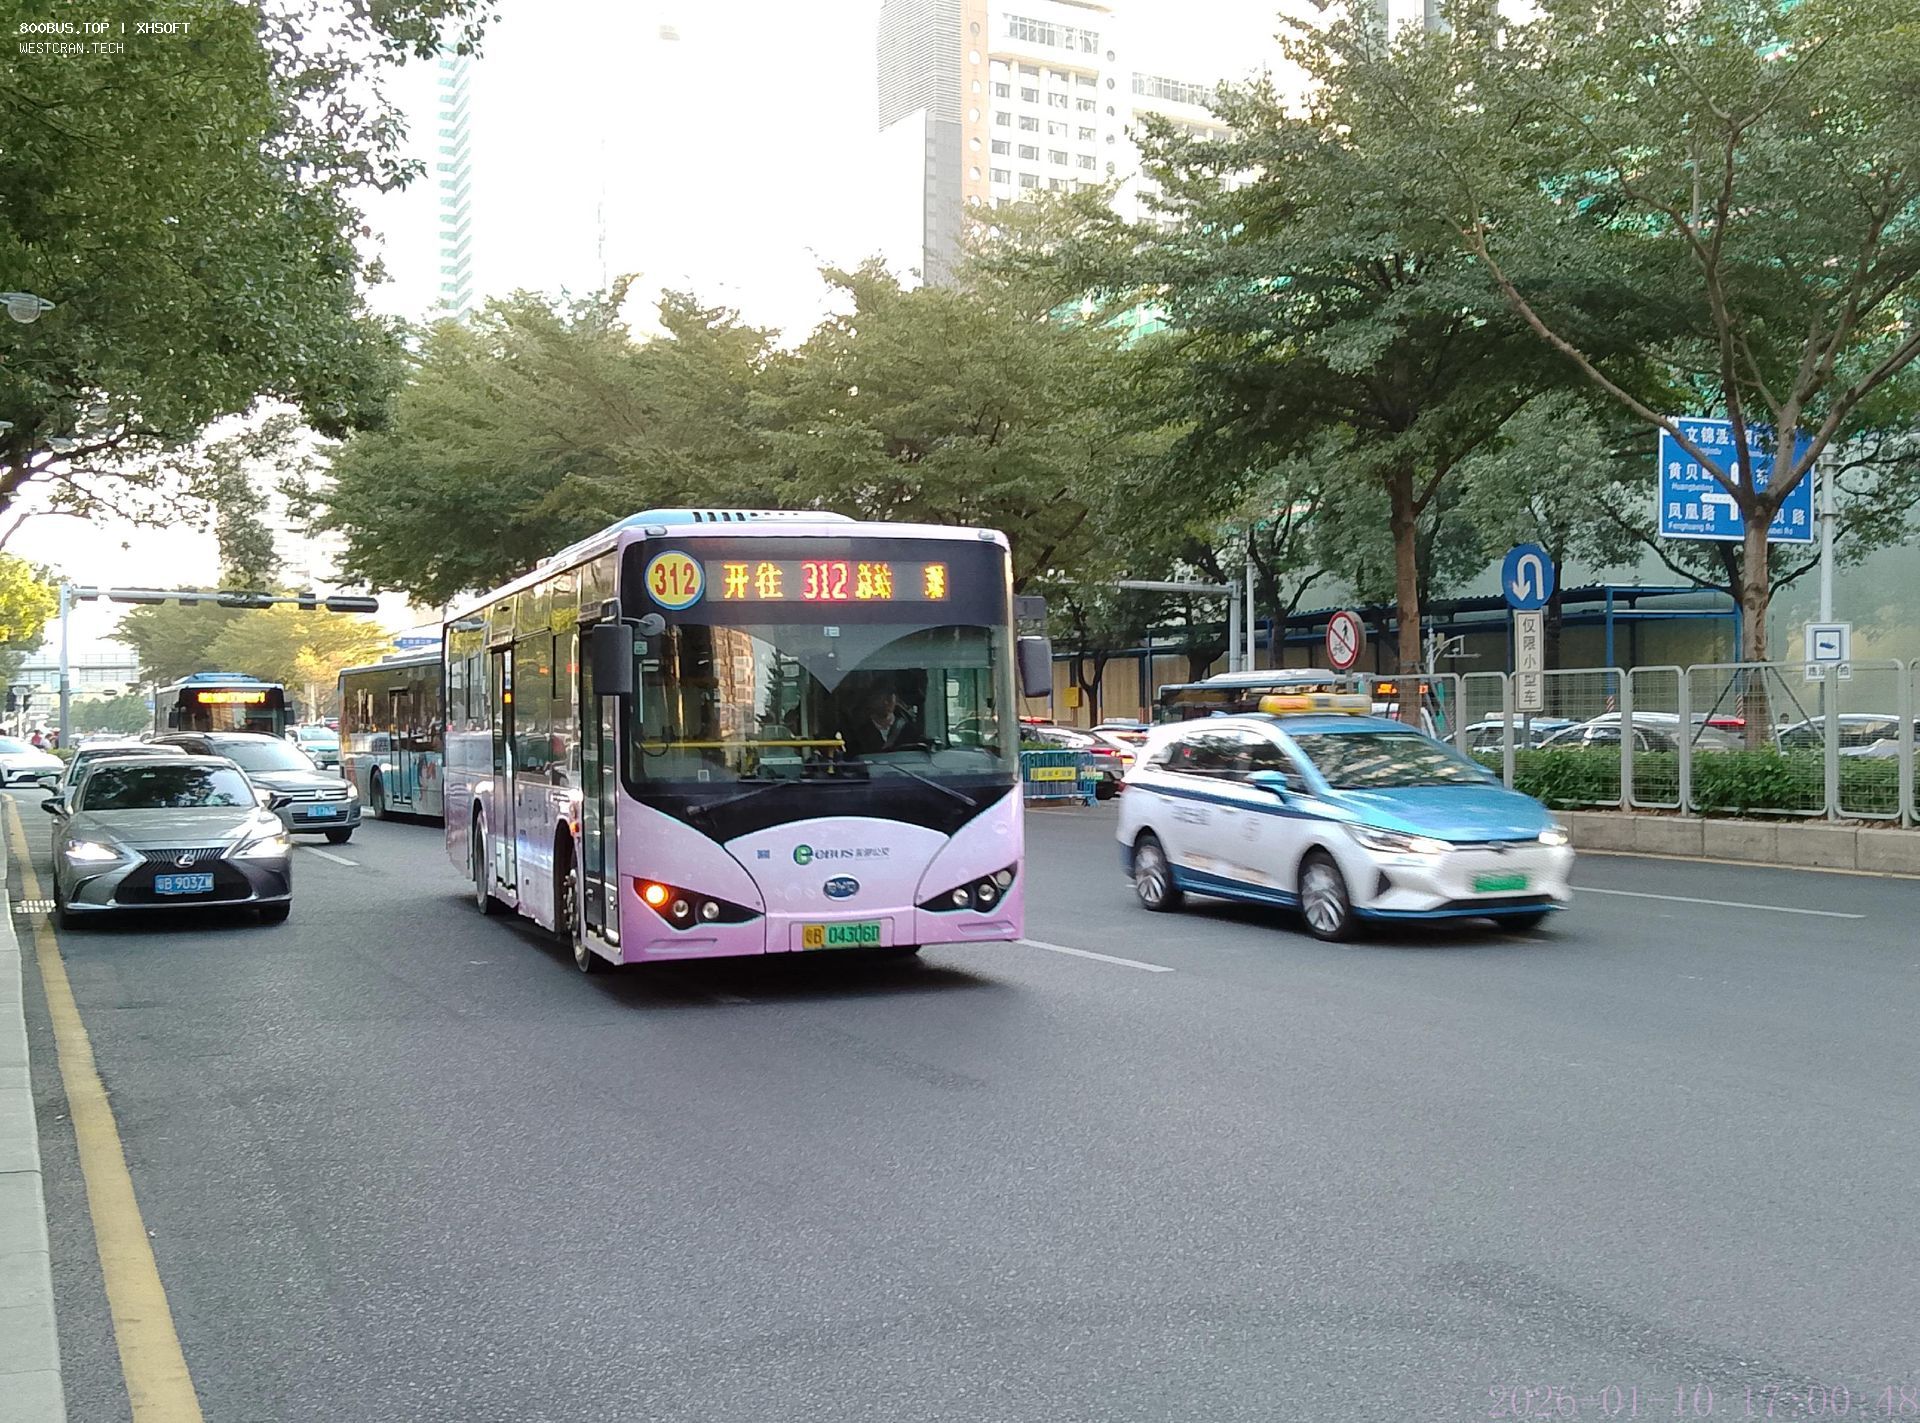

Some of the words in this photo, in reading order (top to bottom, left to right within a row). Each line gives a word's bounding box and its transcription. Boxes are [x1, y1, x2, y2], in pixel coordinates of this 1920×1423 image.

[1668, 502, 1716, 521] 凤凰路
[654, 562, 695, 596] 312
[802, 563, 848, 599] 312
[1523, 618, 1536, 705] 仅限小型车
